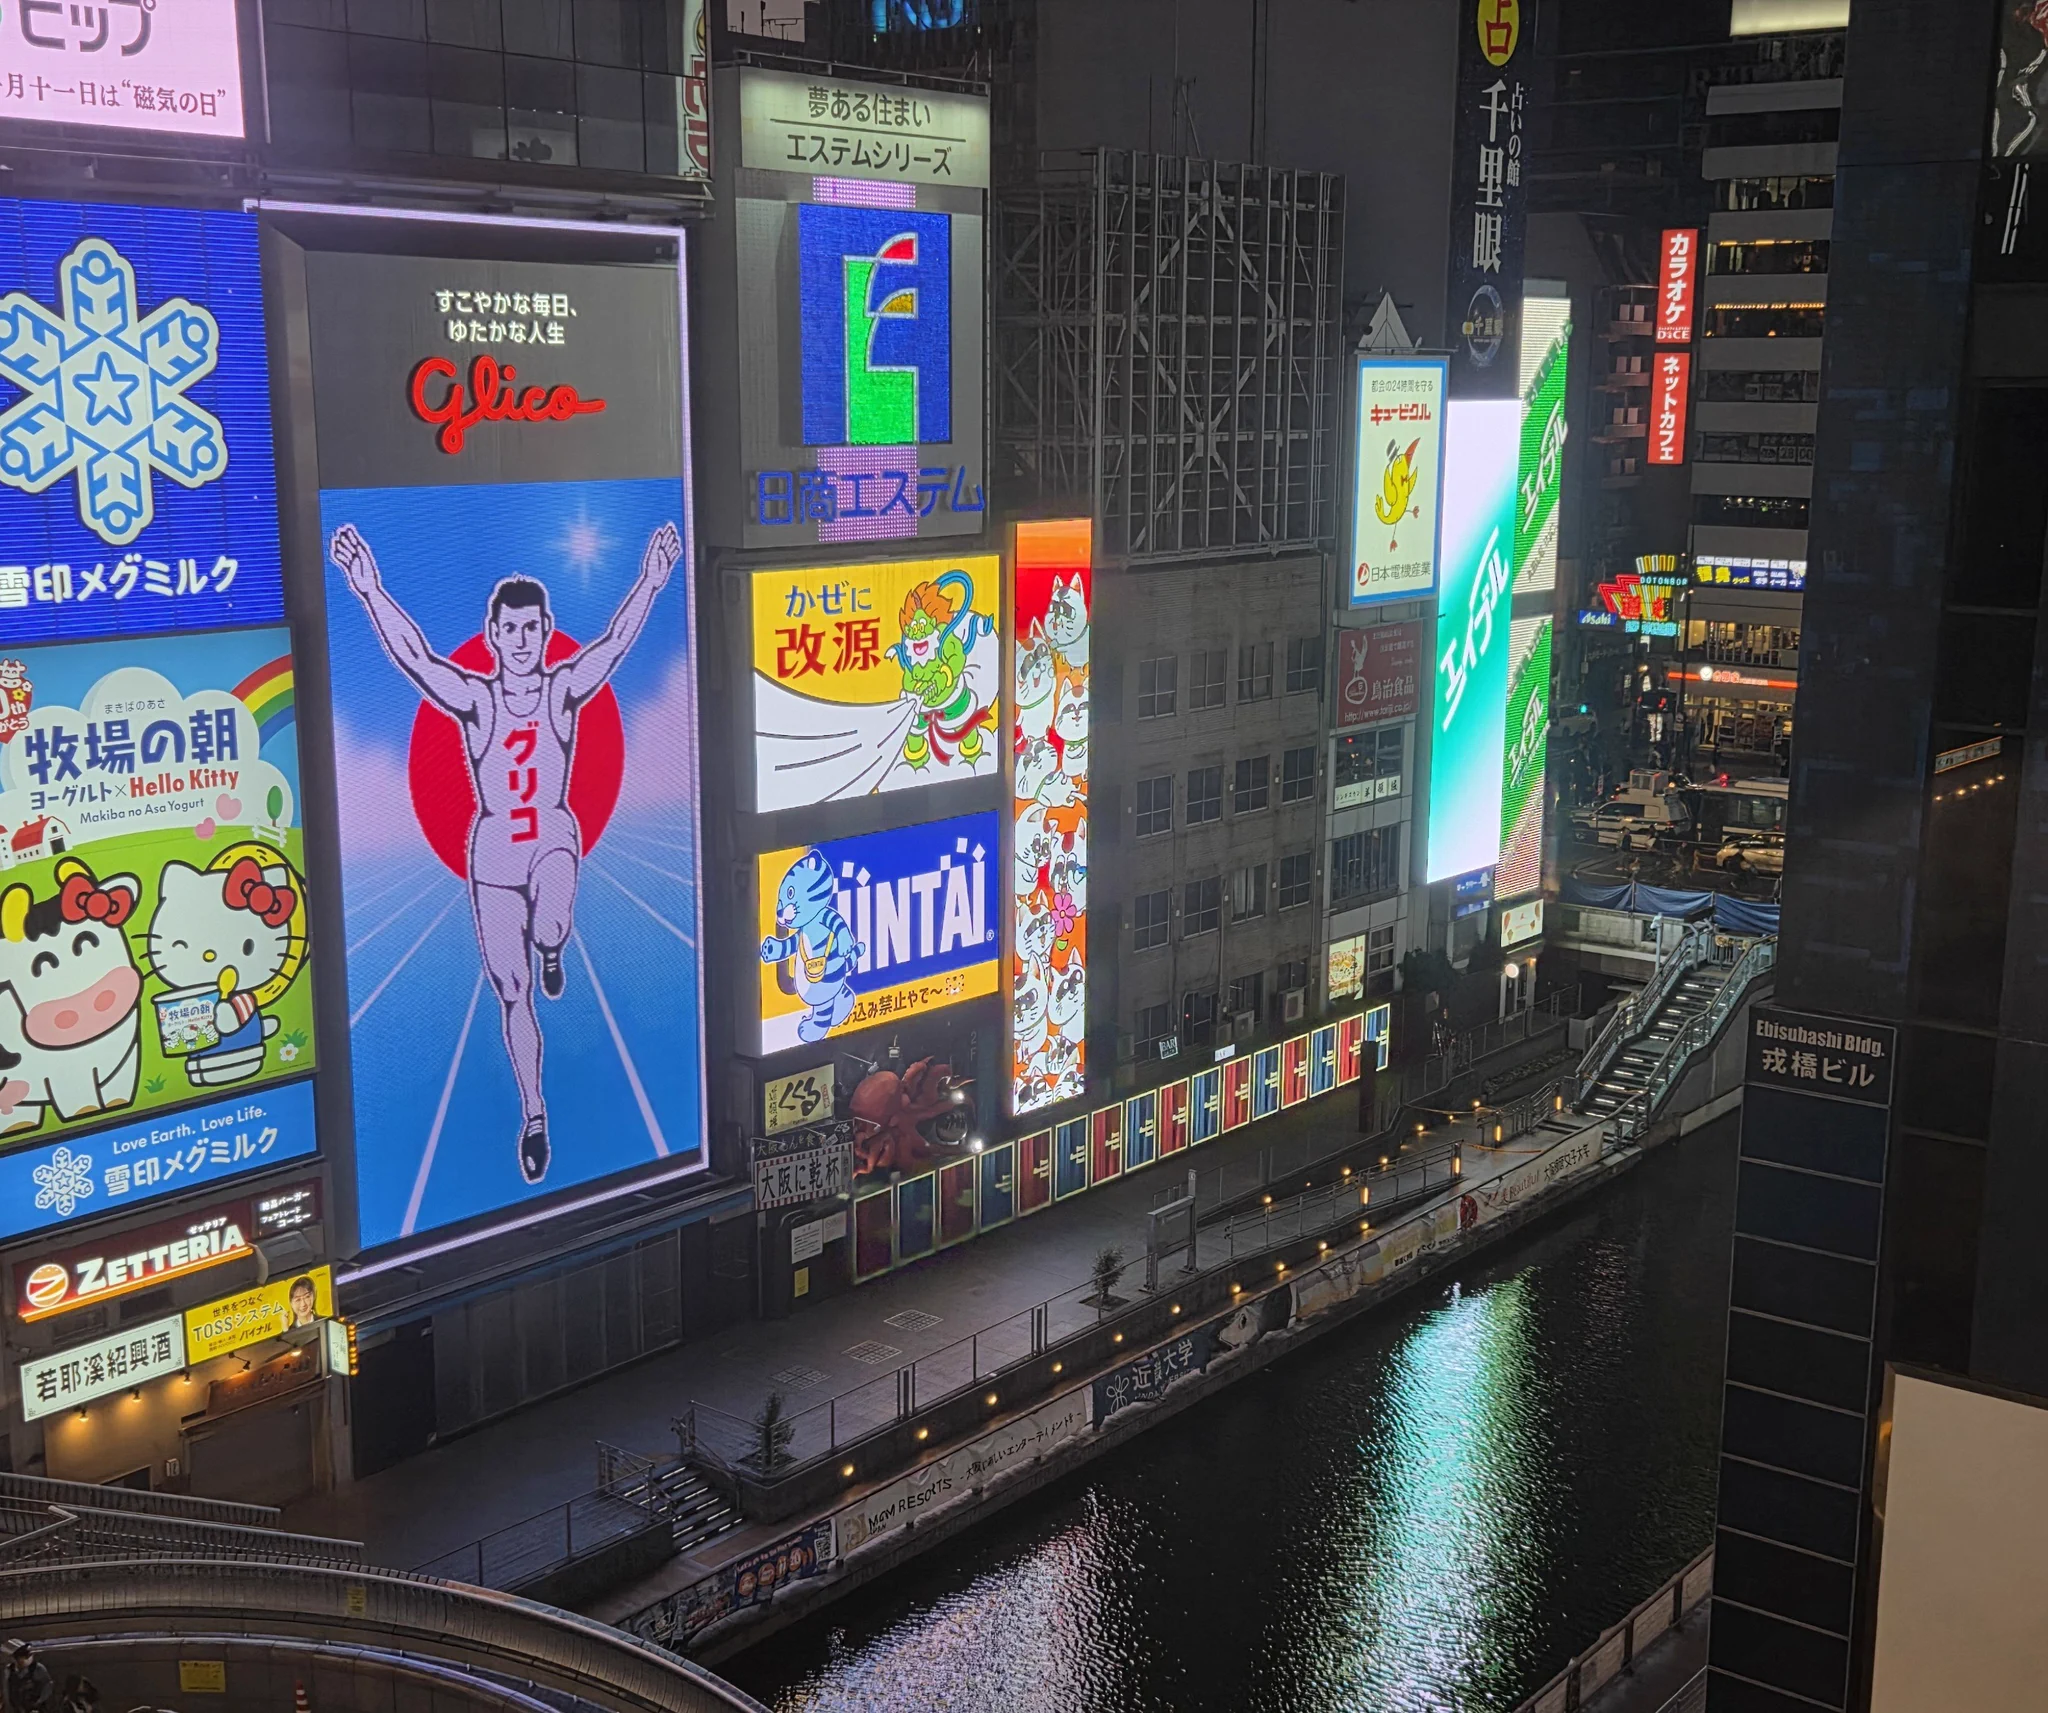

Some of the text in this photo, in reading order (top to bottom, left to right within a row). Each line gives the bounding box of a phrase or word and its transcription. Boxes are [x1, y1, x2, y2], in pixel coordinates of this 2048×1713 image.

[0, 73, 226, 117] 月十一日は“磁気の日”
[808, 86, 931, 127] 夢ある住まい
[787, 133, 952, 175] エステムシリーズ
[1507, 82, 1525, 188] 占いの館
[1473, 79, 1509, 274] 千里眼
[1665, 233, 1690, 324] カラオケ
[435, 289, 577, 317] すこやかな毎日、
[447, 319, 565, 344] ゆたかな人生
[411, 354, 607, 454] Glico
[1371, 380, 1433, 393] 都会の24時間を守る
[1370, 403, 1431, 426] キュービクル
[1659, 355, 1681, 461] ネットカフェ
[758, 465, 985, 525] 日商エステム
[0, 553, 238, 608] 雪印メグミルク
[1371, 561, 1431, 583] 日本電機産業
[785, 580, 872, 618] かぜに
[1581, 611, 1611, 625] Asahi
[775, 617, 881, 679] 改源
[104, 698, 166, 714] まきばのあさ
[25, 707, 239, 785] 牧場の朝
[129, 772, 185, 799] Hello
[190, 768, 240, 790] Kitty
[503, 720, 539, 843] グリコ
[80, 797, 205, 825] Makiba no Asa Yogurt
[169, 1004, 210, 1021] 牧場の朝
[1756, 1020, 1886, 1058] Ebisubashi Bldg.
[1762, 1047, 1876, 1088] 戎橋ビル
[113, 1106, 268, 1155] Love Earth. Love Life.
[104, 1126, 279, 1198] 雪印メグミルク
[761, 1156, 841, 1200] 大阪に乾杯
[187, 1216, 228, 1235] ゼッテリア
[276, 1213, 312, 1228] コーヒー
[75, 1224, 248, 1296] ZETTERIA
[192, 1301, 284, 1342] TOSSシステム
[212, 1293, 264, 1318] 世界をつなぐ
[868, 1503, 896, 1534] MGM
